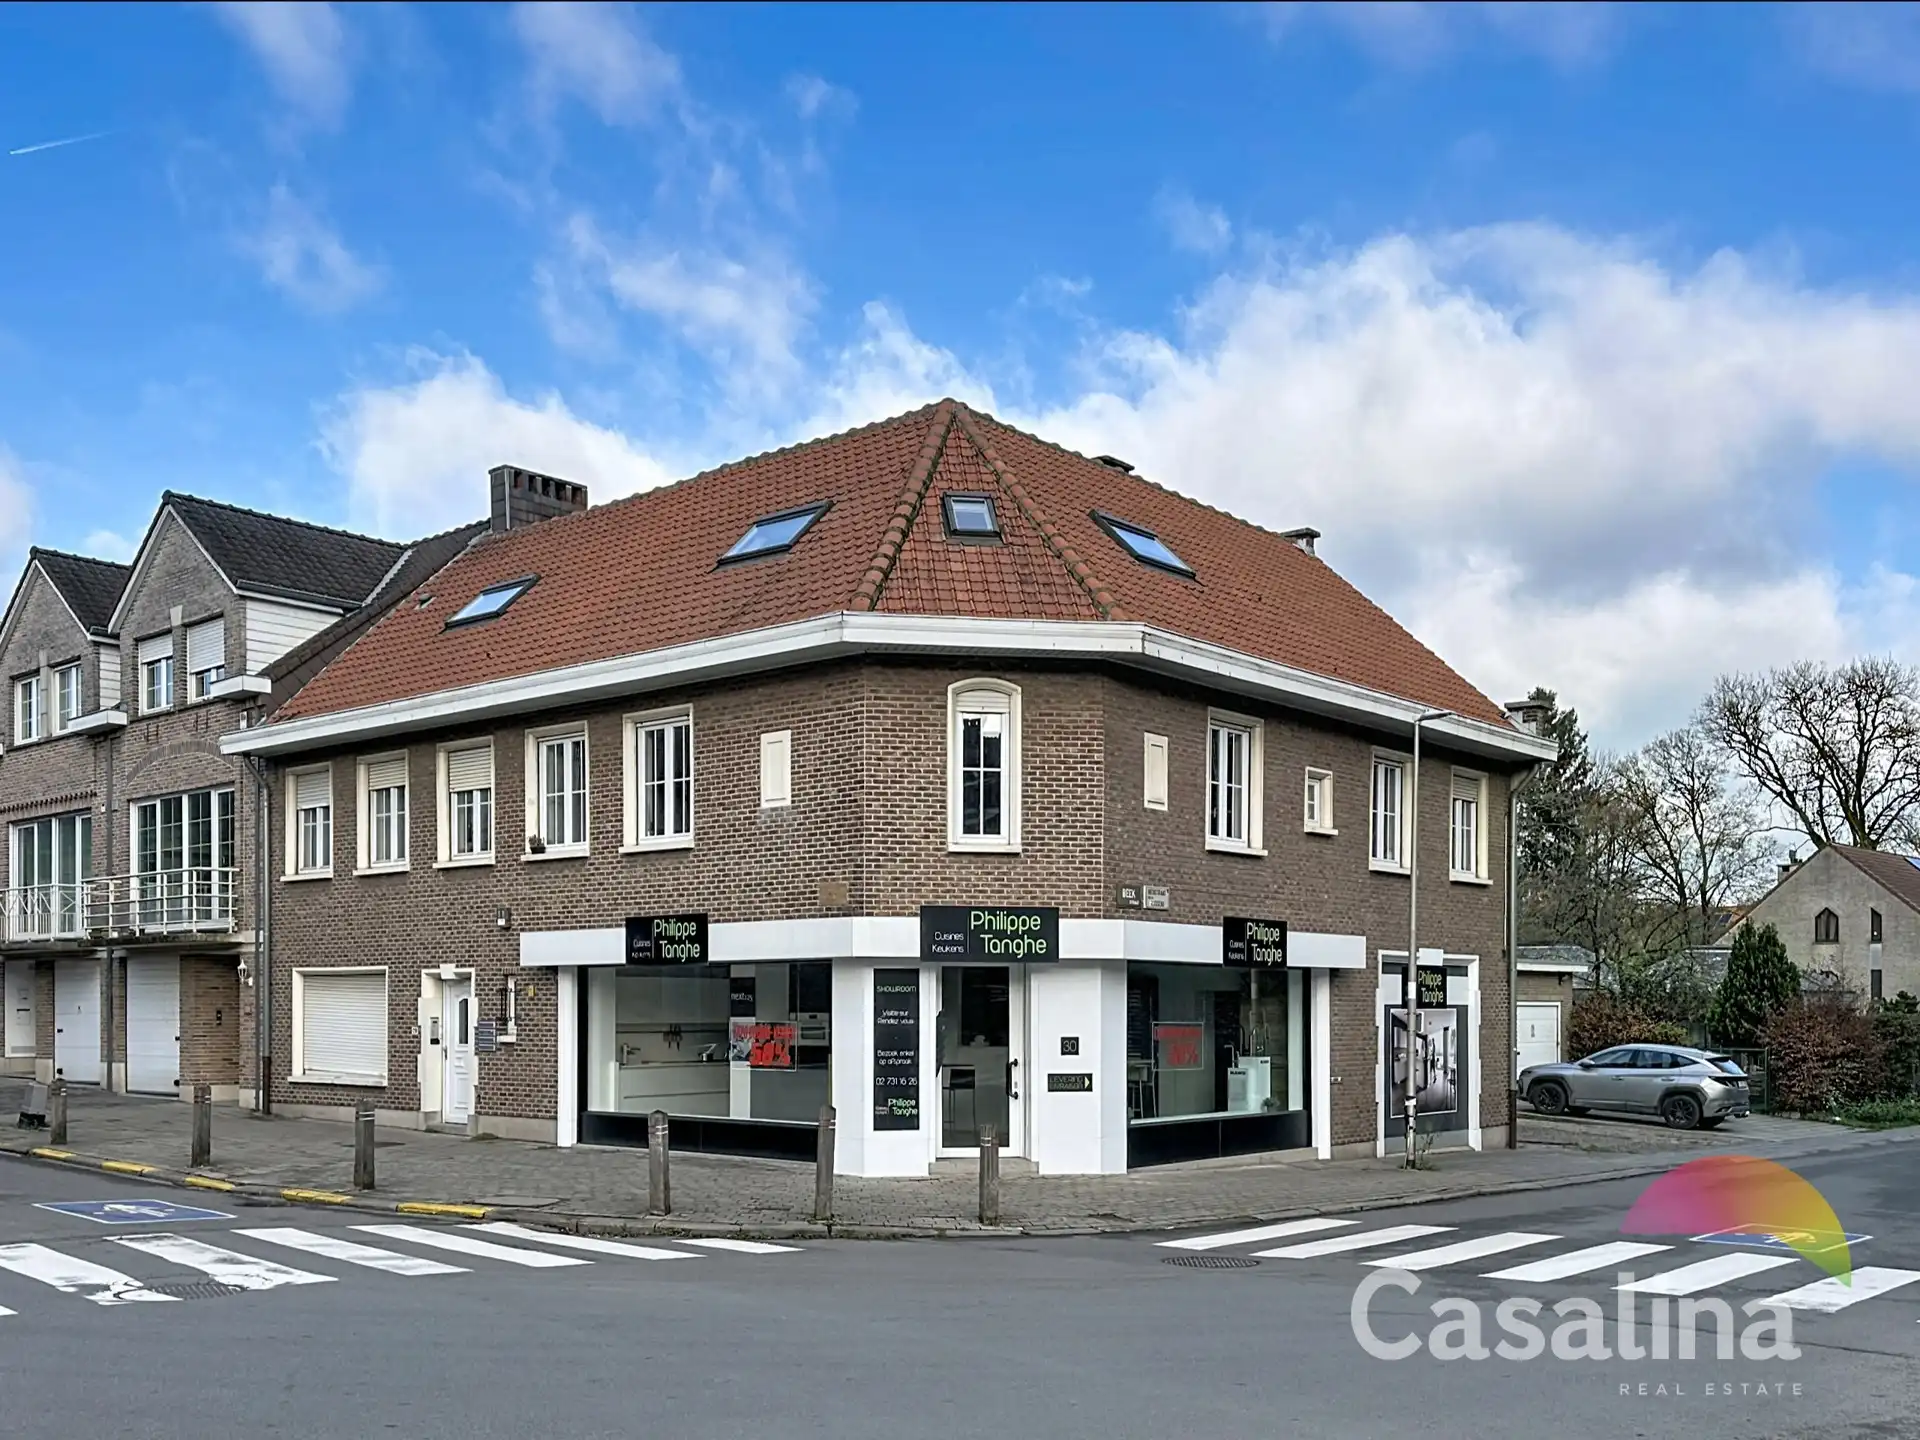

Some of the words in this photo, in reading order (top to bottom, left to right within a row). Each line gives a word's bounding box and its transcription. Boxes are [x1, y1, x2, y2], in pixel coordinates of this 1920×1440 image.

[654, 918, 697, 941] Philippe
[970, 911, 1041, 935] Philippe
[934, 931, 964, 941] Cuisines
[1247, 922, 1280, 945] Philippe
[659, 940, 700, 962] Tanghe
[932, 944, 964, 953] Keukens
[980, 935, 1047, 958] Tanghe
[1251, 943, 1283, 966] Tanghe
[1418, 970, 1442, 988] Philippe
[1421, 987, 1444, 1006] Tanghe
[1063, 1040, 1077, 1052] 30
[875, 1076, 885, 1086] 02
[886, 1076, 898, 1086] 731
[888, 1098, 916, 1107] Philippe
[892, 1107, 918, 1117] Tanghe
